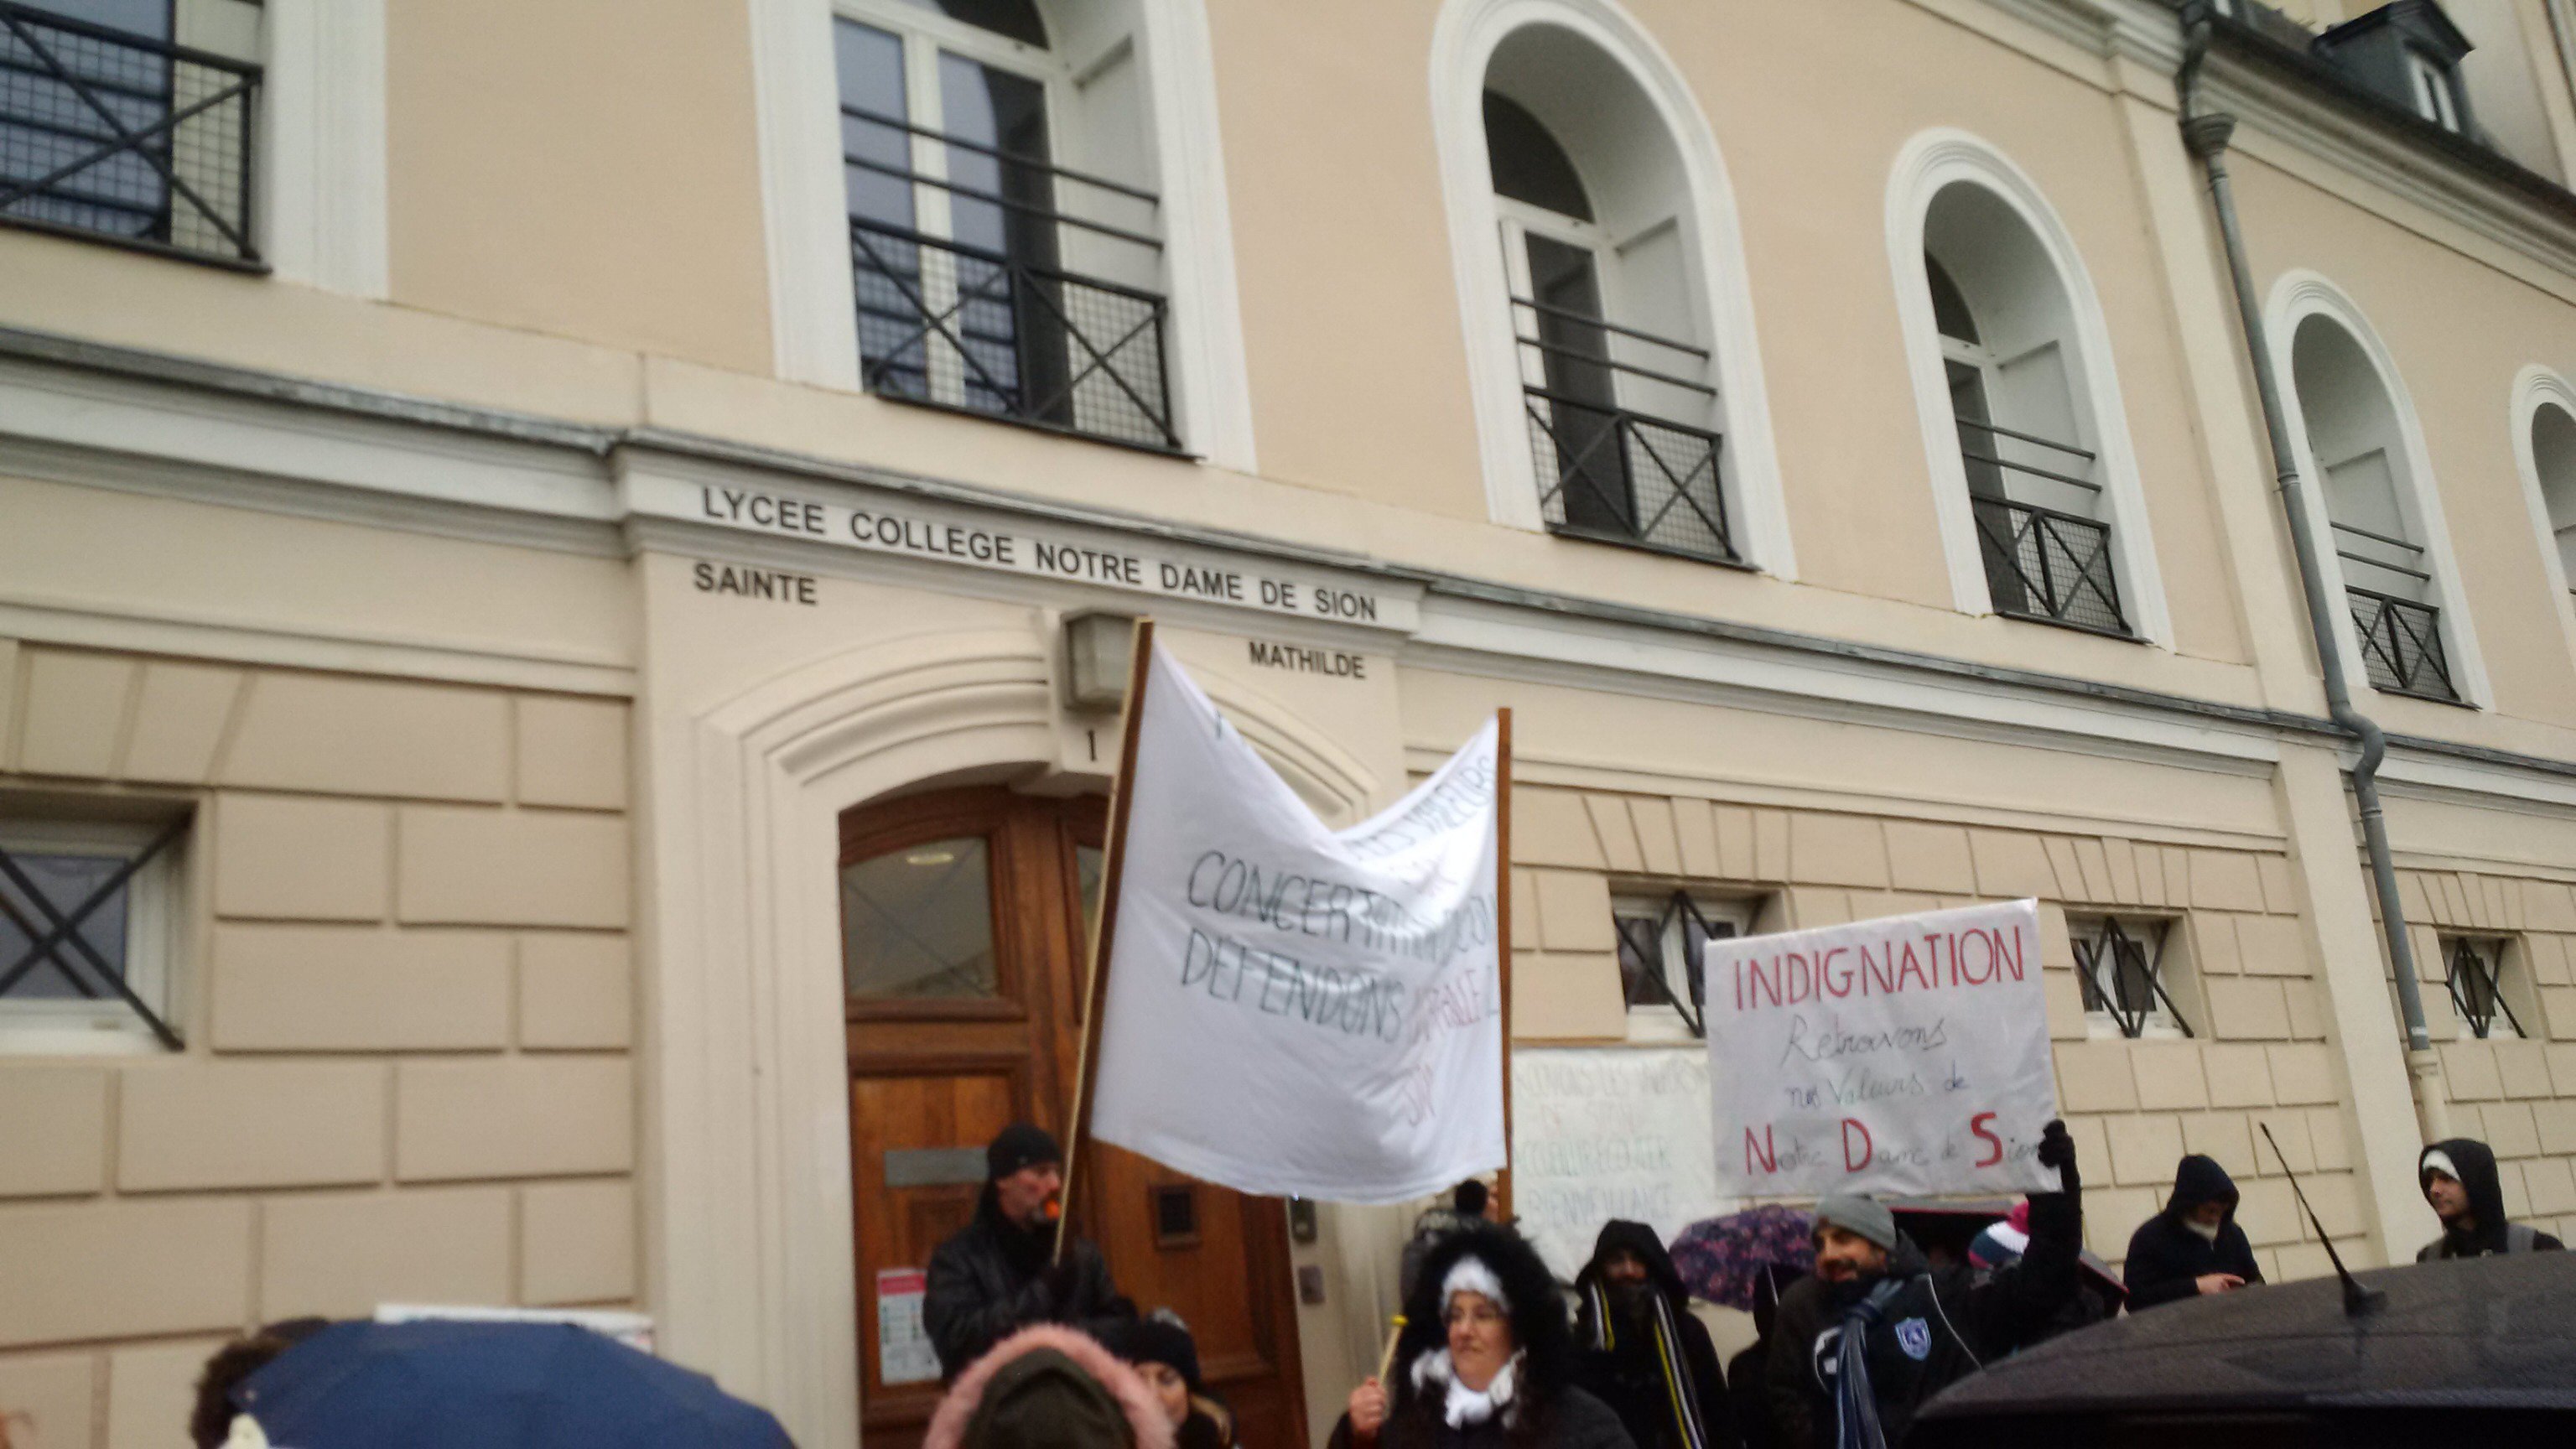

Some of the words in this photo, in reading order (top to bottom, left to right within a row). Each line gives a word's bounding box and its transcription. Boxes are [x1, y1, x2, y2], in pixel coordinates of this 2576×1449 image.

[693, 562, 818, 606] SAINTE
[702, 486, 826, 535] LYCEE
[849, 511, 1016, 565] COLLEGE
[1035, 542, 1143, 585] NOTRE
[1160, 562, 1244, 600] DAME
[1260, 579, 1298, 608] DE
[1315, 589, 1378, 622] SION
[1248, 640, 1368, 680] MATHILDE
[1734, 925, 2025, 1010] INDIGNATION
